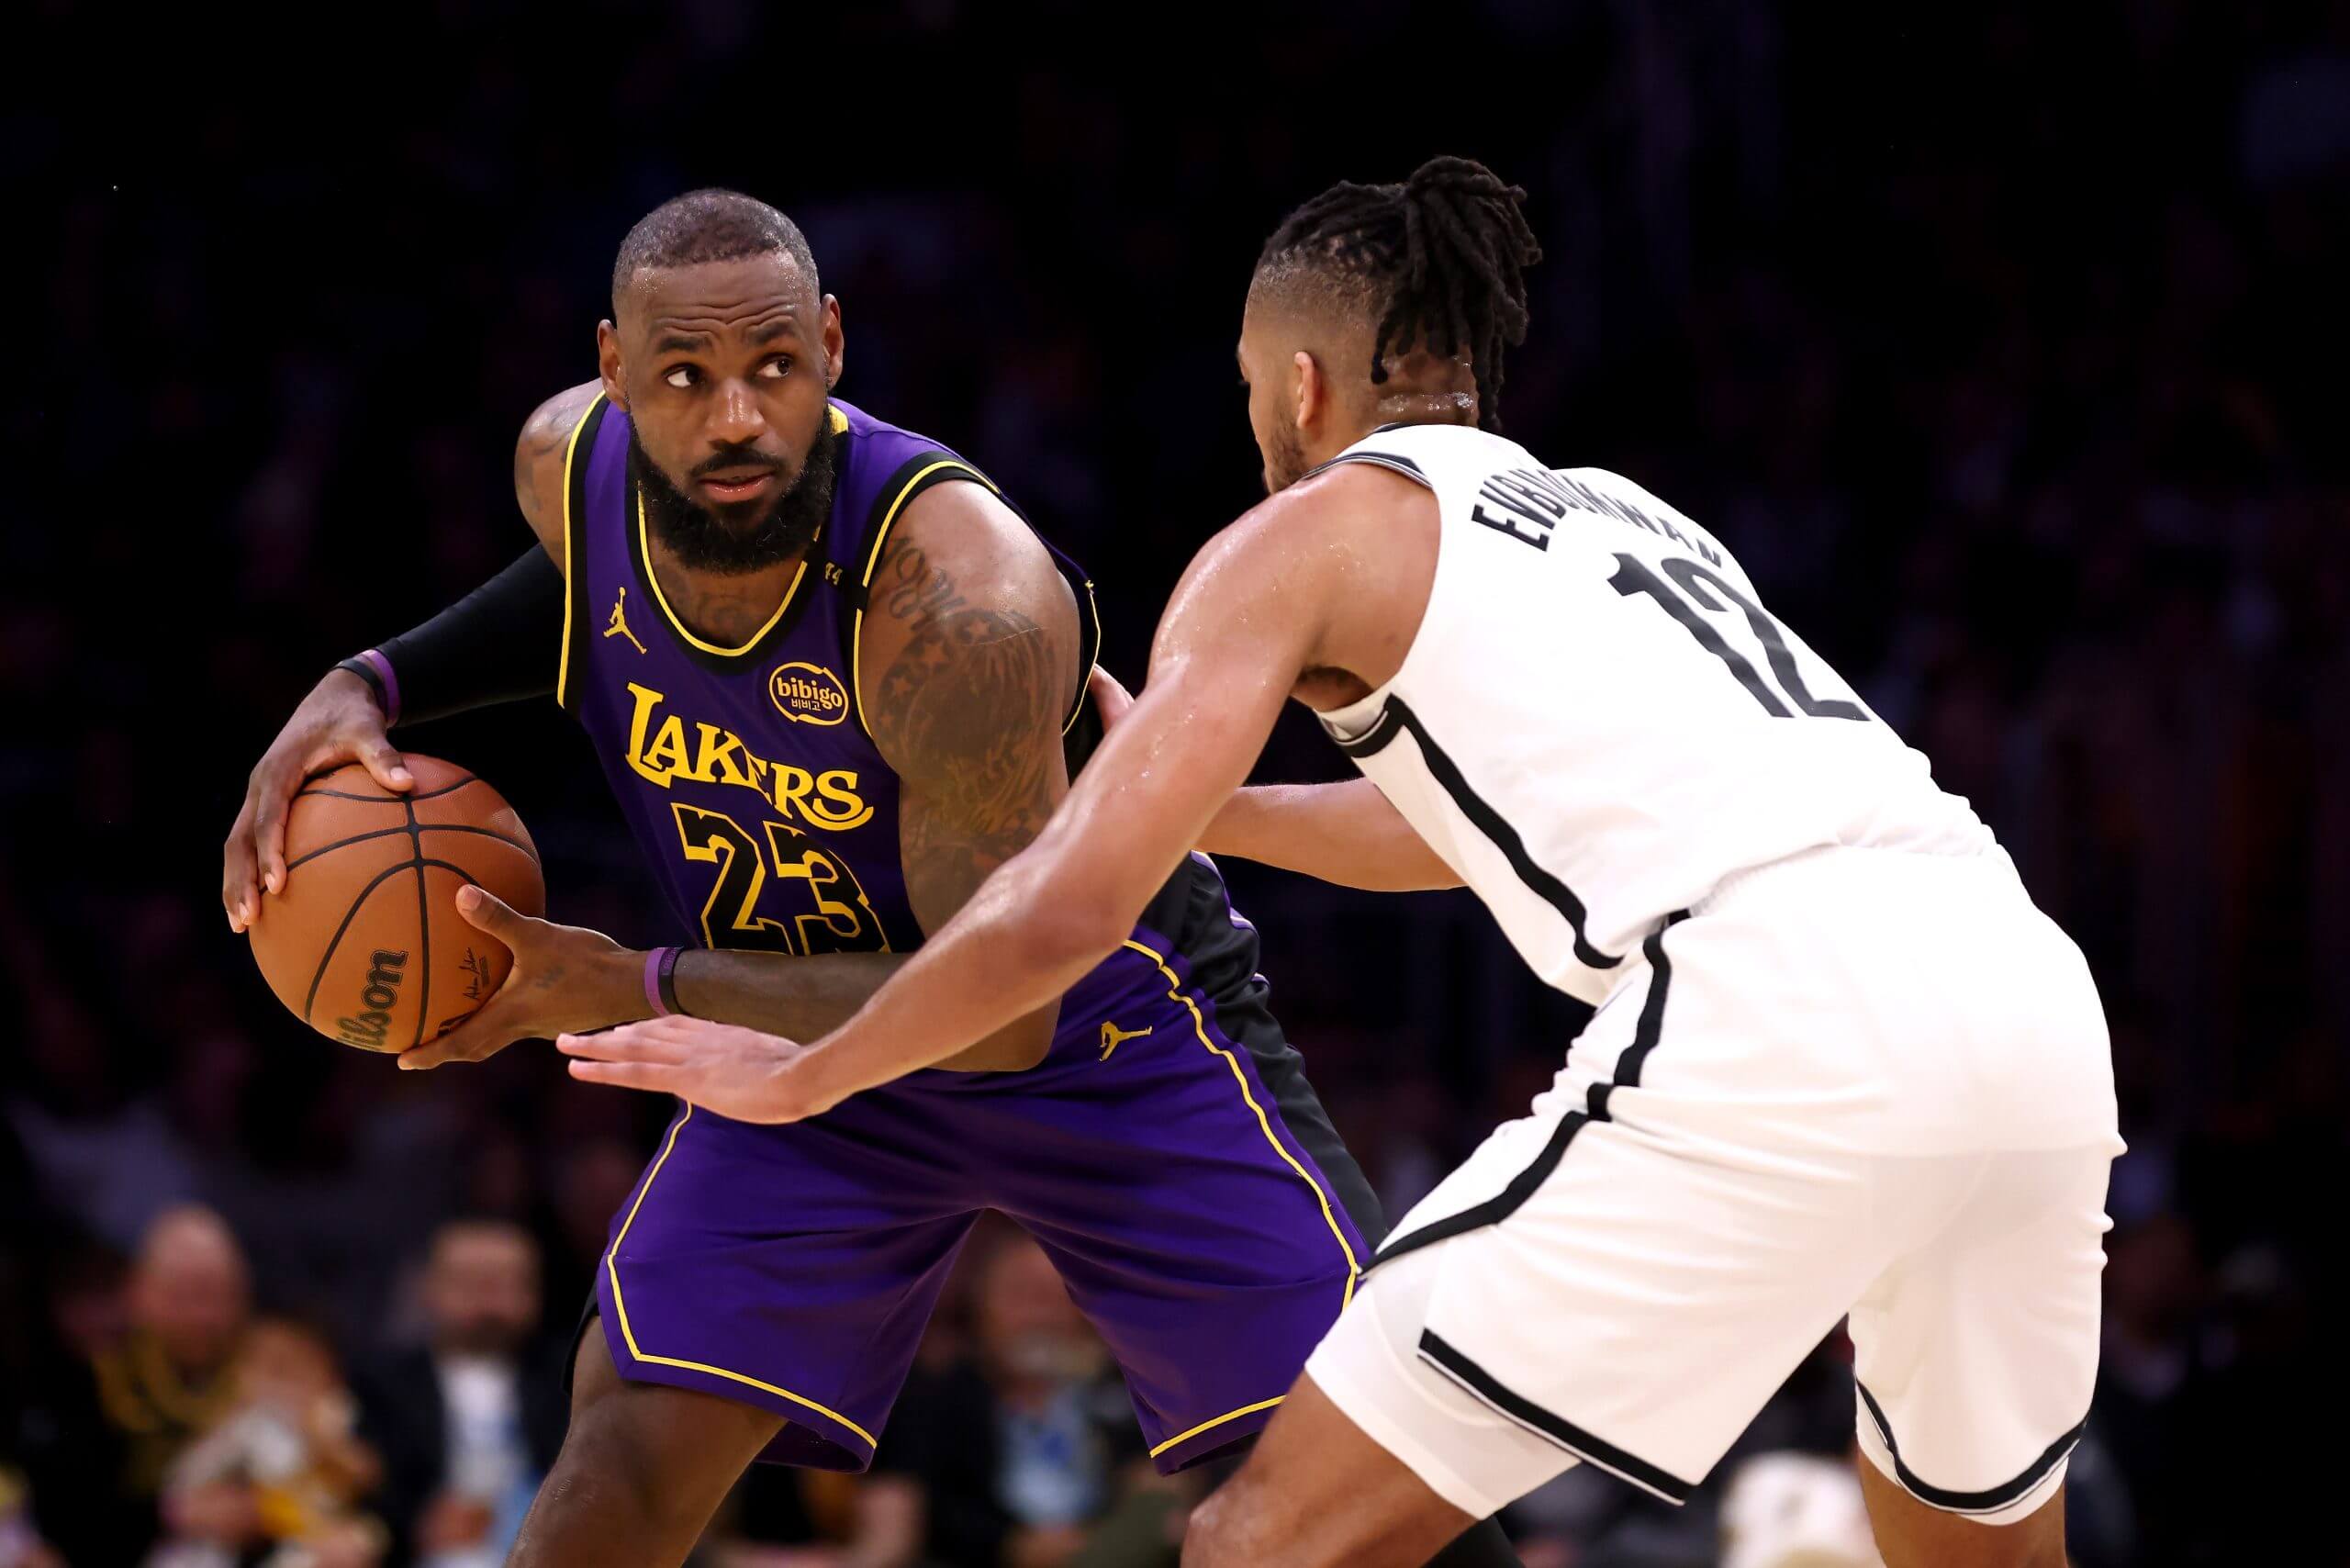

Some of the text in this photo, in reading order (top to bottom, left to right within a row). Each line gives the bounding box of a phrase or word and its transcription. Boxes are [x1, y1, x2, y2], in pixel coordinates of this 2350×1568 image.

[776, 677, 843, 710] bibigo
[790, 698, 822, 711] 비비고
[1606, 553, 1872, 721] 12
[626, 682, 874, 831] LAKERS
[670, 802, 890, 956] 23
